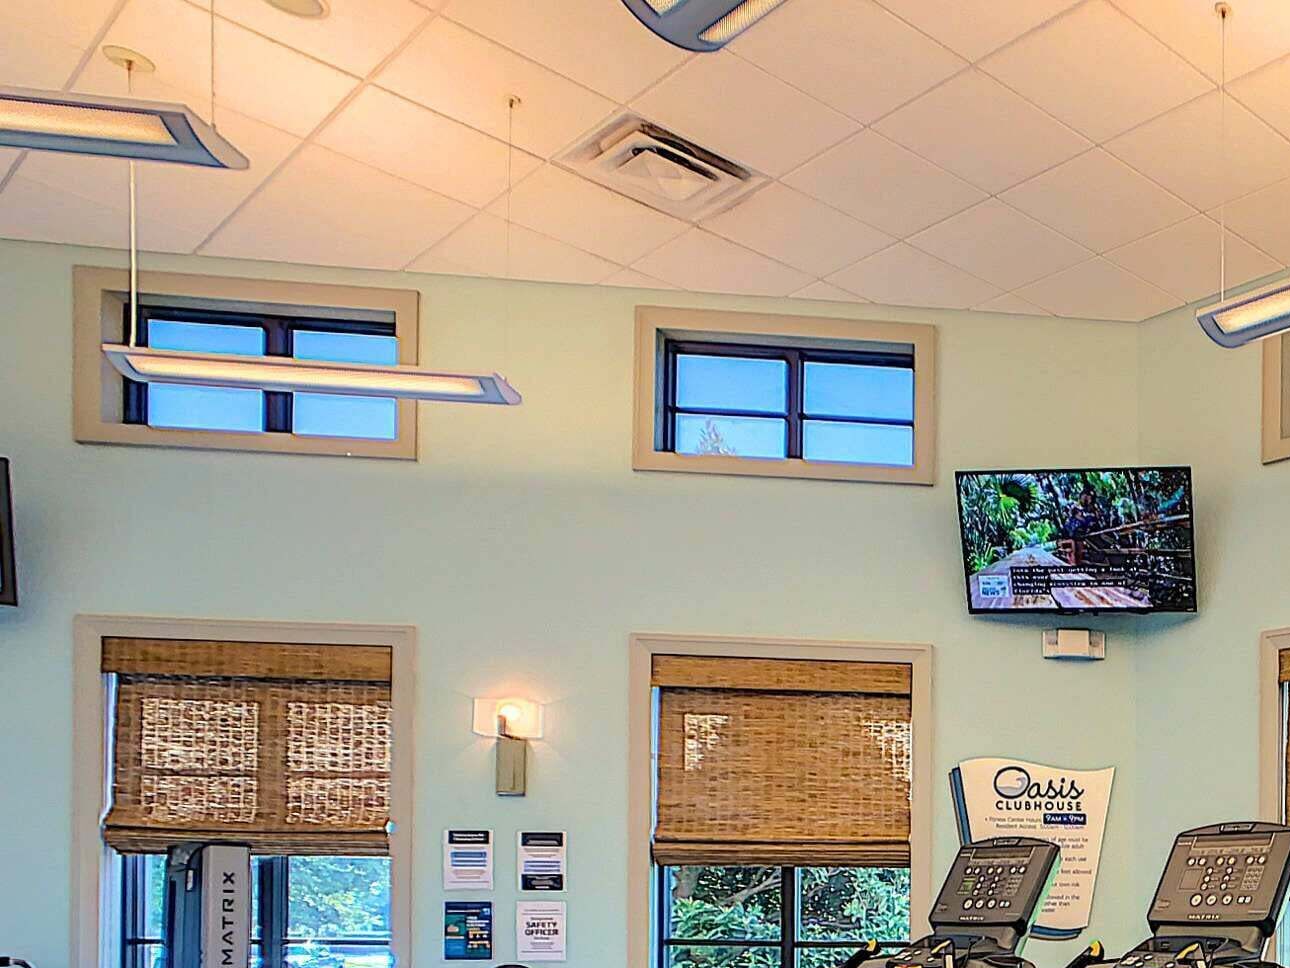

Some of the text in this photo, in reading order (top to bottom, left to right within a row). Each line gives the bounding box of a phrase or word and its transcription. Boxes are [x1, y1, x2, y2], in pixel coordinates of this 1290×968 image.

[993, 766, 1085, 800] Oasis
[995, 801, 1083, 812] CLUBHOUSE
[221, 871, 236, 965] MATRIX
